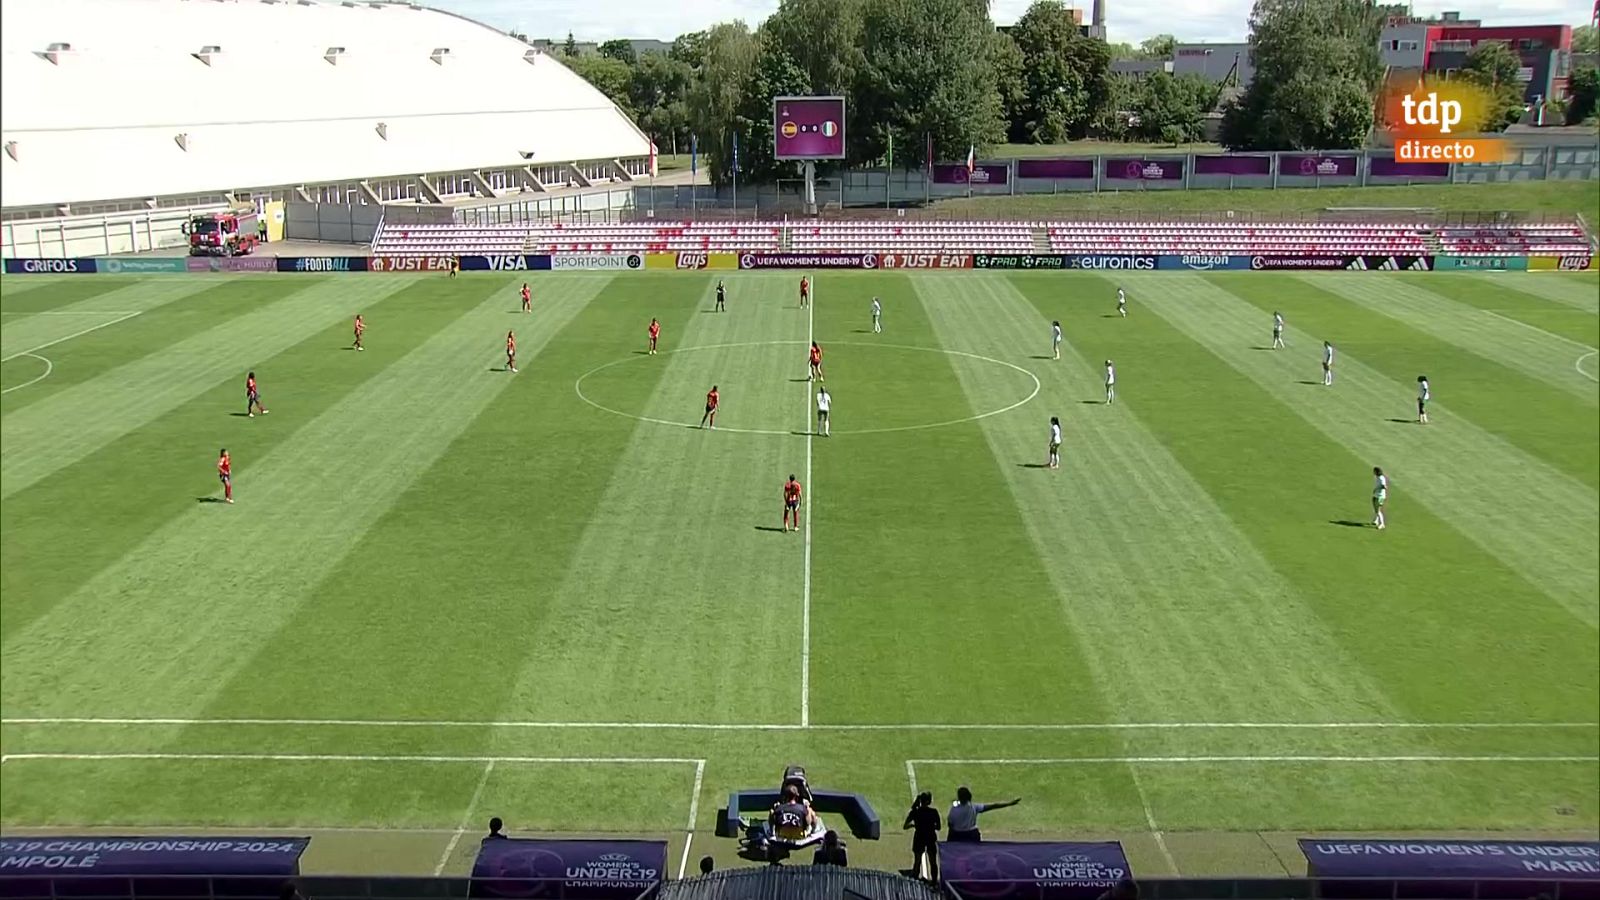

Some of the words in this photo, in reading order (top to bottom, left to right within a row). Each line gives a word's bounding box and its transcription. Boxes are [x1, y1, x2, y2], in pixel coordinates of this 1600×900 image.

[24, 260, 77, 272] GRIFOLS
[295, 258, 350, 271] #FOOTBALL
[389, 258, 423, 271] JUST
[487, 256, 528, 269] VISA
[555, 257, 625, 267] SPORTPOINT
[757, 257, 779, 265] UEFA
[780, 257, 820, 265] WOMEN'S
[821, 257, 860, 265] UNDER-19
[901, 255, 936, 268] JUST
[940, 255, 968, 267] EAT
[1081, 255, 1154, 269] euronics
[1182, 255, 1229, 265] amazon
[44, 841, 233, 852] CHAMPIONSHIP
[232, 842, 293, 853] 2024
[1315, 844, 1381, 854] UEFA
[1379, 844, 1505, 857] WOMEN'S
[1522, 860, 1599, 873] MARI
[566, 868, 656, 879] UNDER-19
[1033, 868, 1124, 879] UNDER-19
